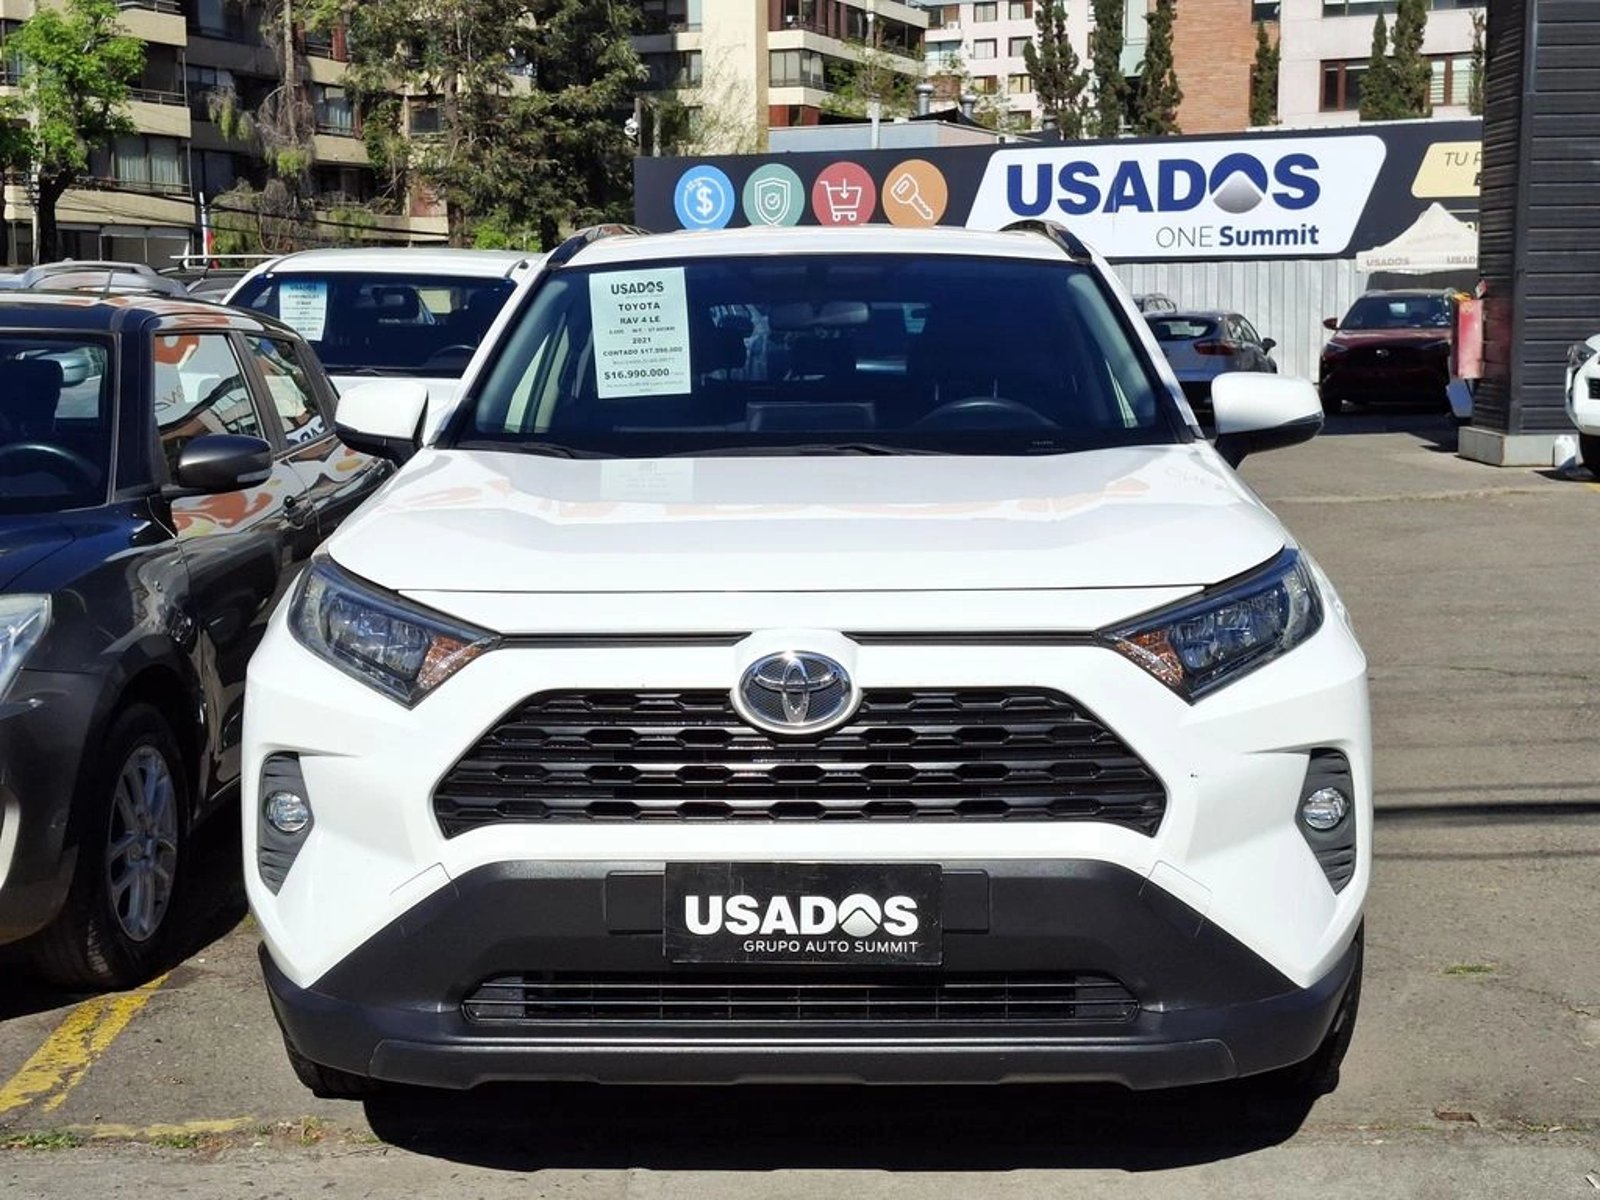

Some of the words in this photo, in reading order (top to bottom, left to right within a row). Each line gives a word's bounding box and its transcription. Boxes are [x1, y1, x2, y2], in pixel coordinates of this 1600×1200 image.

[1445, 151, 1469, 166] TU
[1007, 152, 1320, 216] USADOS
[1156, 226, 1213, 249] ONE
[1219, 223, 1319, 247] Summit
[611, 281, 664, 295] USADOS
[618, 302, 661, 312] TOYOTA
[602, 348, 638, 357] CONTADO
[604, 367, 670, 380] $16.990.000
[685, 893, 919, 937] USADOS
[743, 940, 800, 952] GRUPO
[805, 940, 849, 953] AUTO
[854, 941, 919, 954] SUMMIT
